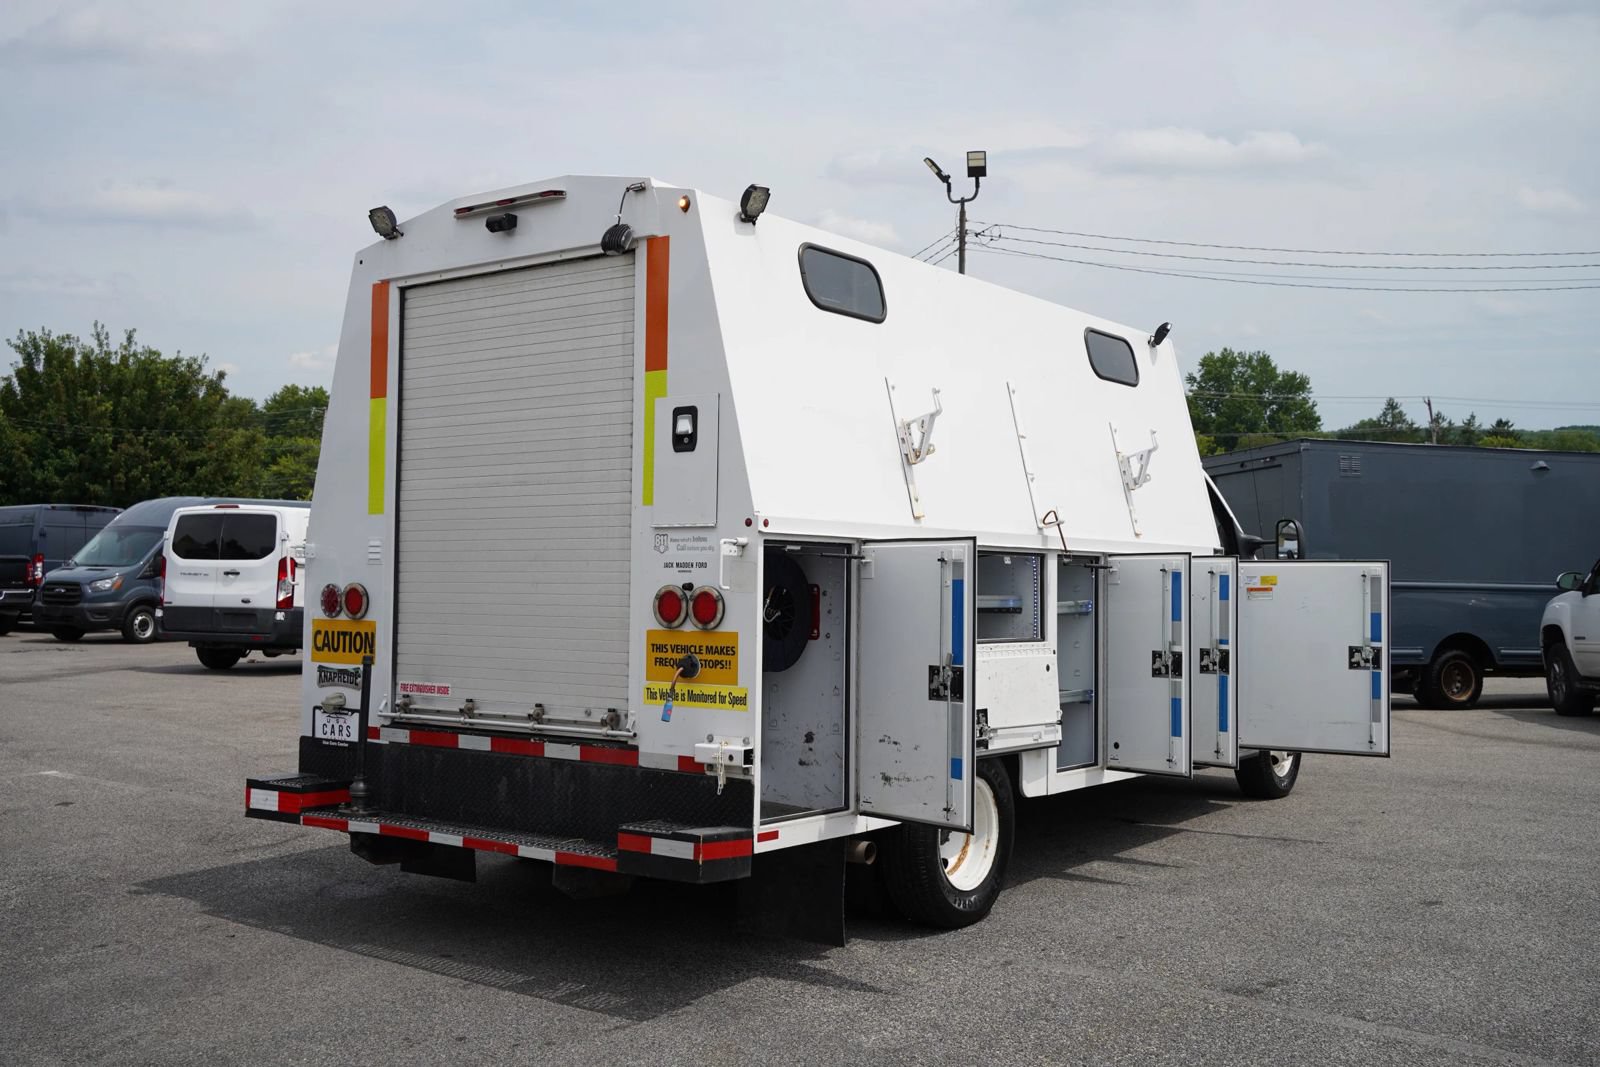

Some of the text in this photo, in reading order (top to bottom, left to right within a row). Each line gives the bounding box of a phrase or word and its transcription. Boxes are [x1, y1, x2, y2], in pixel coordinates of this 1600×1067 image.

[313, 630, 375, 654] CAUTION
[651, 644, 736, 656] THIS VEHICLE MAKES
[654, 657, 731, 669] FREQU STOPS!!
[646, 687, 747, 707] This Vehle is Monitored for Speed
[322, 723, 351, 738] CARS
